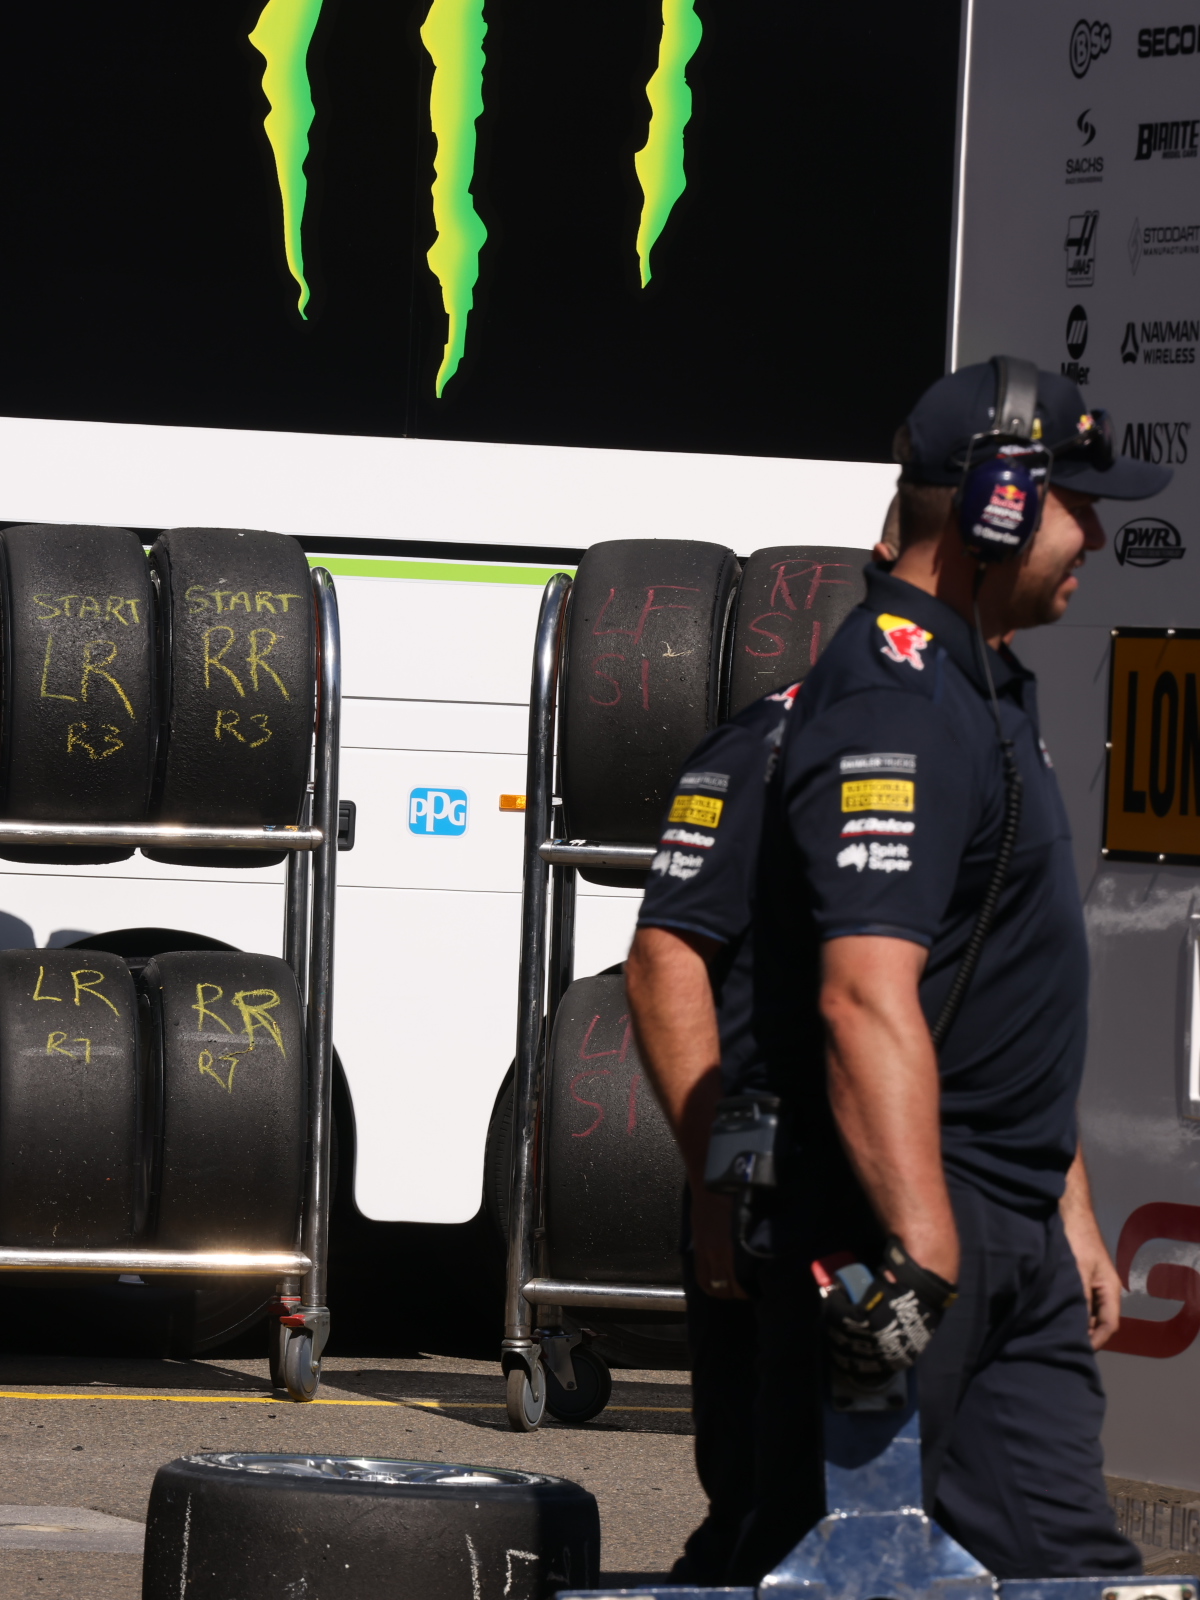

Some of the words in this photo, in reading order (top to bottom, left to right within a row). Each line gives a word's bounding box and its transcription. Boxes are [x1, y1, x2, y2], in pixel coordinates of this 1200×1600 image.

[1138, 25, 1200, 58] SECO
[1065, 157, 1104, 174] SACHS
[1140, 320, 1200, 343] NAVMAN
[1143, 347, 1196, 365] WIRELESS
[1121, 422, 1188, 464] ANSYS
[36, 595, 141, 626] START
[184, 585, 304, 615] START
[591, 585, 700, 644] LF
[40, 633, 137, 720] LR
[204, 624, 291, 701] RR
[66, 721, 125, 760] R3
[215, 708, 273, 749] R3
[410, 791, 466, 832] PPG
[32, 965, 120, 1020] LR
[191, 982, 289, 1061] RR
[49, 1030, 92, 1064] R7
